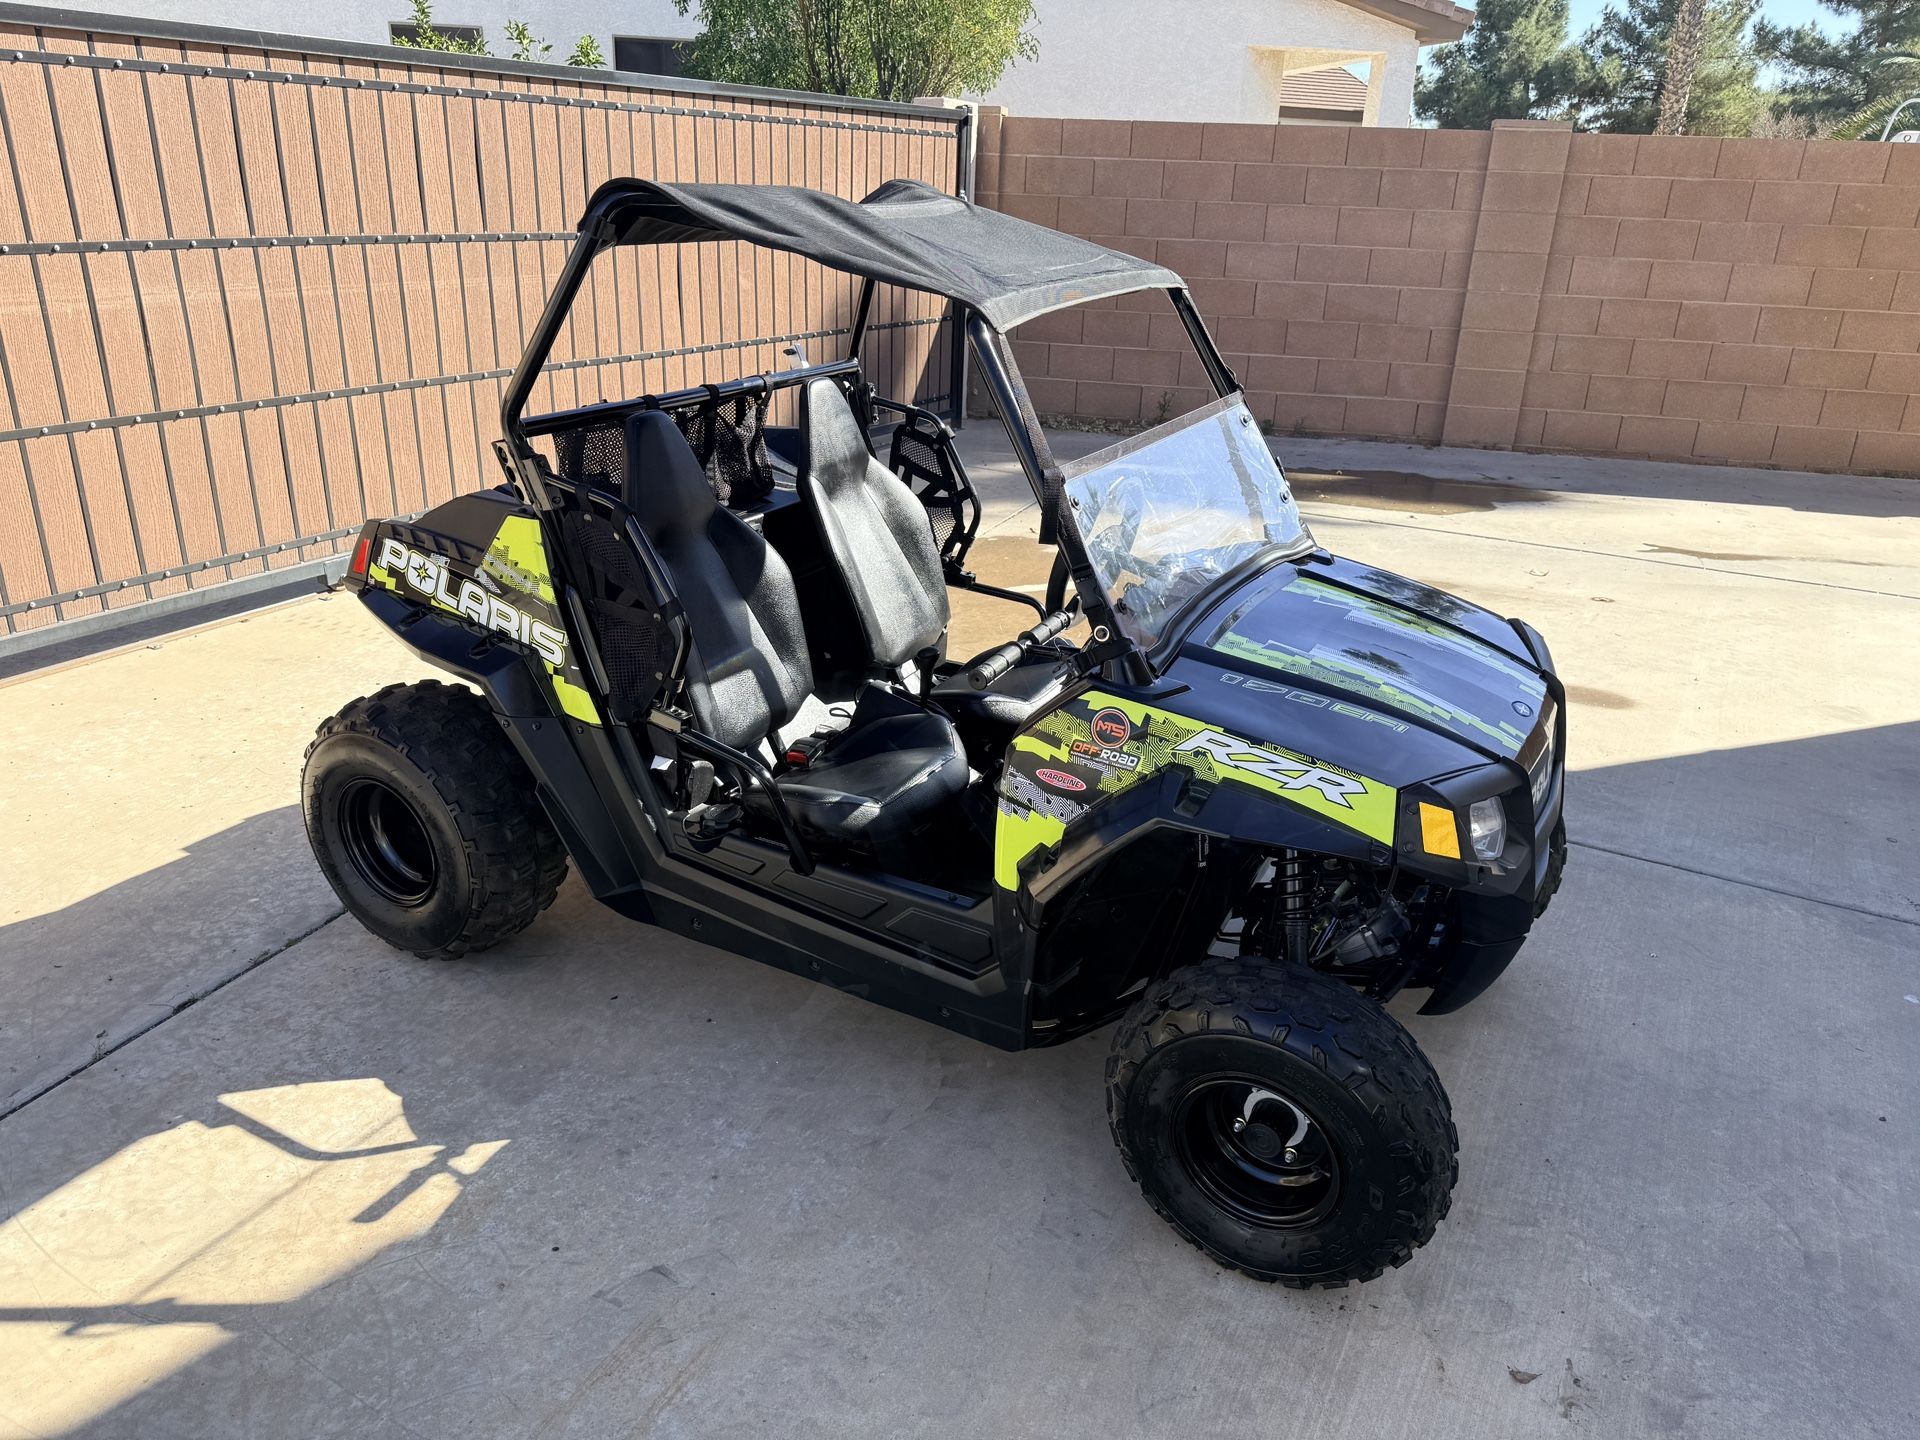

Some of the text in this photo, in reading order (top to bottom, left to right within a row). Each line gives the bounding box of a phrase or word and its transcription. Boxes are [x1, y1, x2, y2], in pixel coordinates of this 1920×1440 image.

[380, 537, 566, 667] POLARIS
[1096, 720, 1126, 738] MTS
[1042, 770, 1081, 788] HARDLINE
[1171, 728, 1368, 810] RZR
